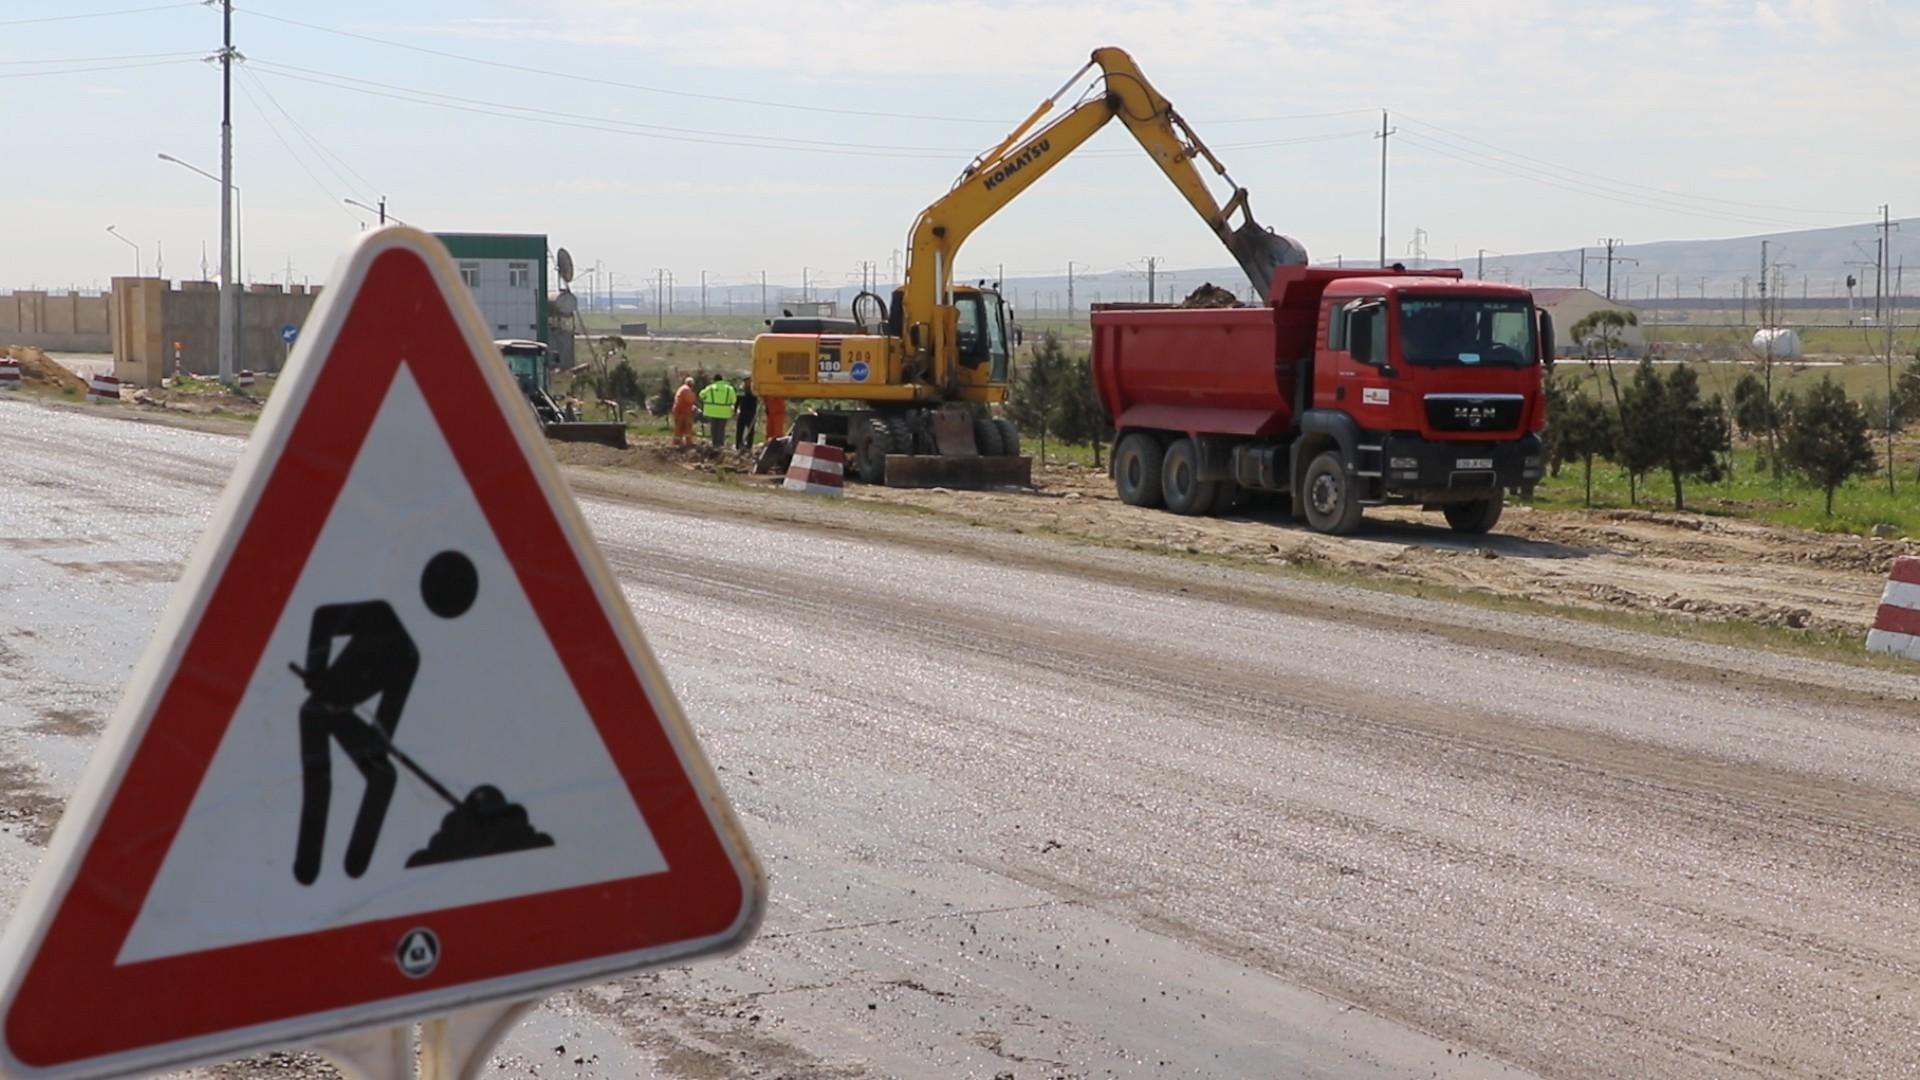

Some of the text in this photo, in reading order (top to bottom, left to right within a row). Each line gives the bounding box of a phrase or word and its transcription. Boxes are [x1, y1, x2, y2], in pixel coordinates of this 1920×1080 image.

[983, 138, 1051, 190] KOMATSU
[819, 361, 841, 371] 180
[1454, 407, 1496, 418] MAN
